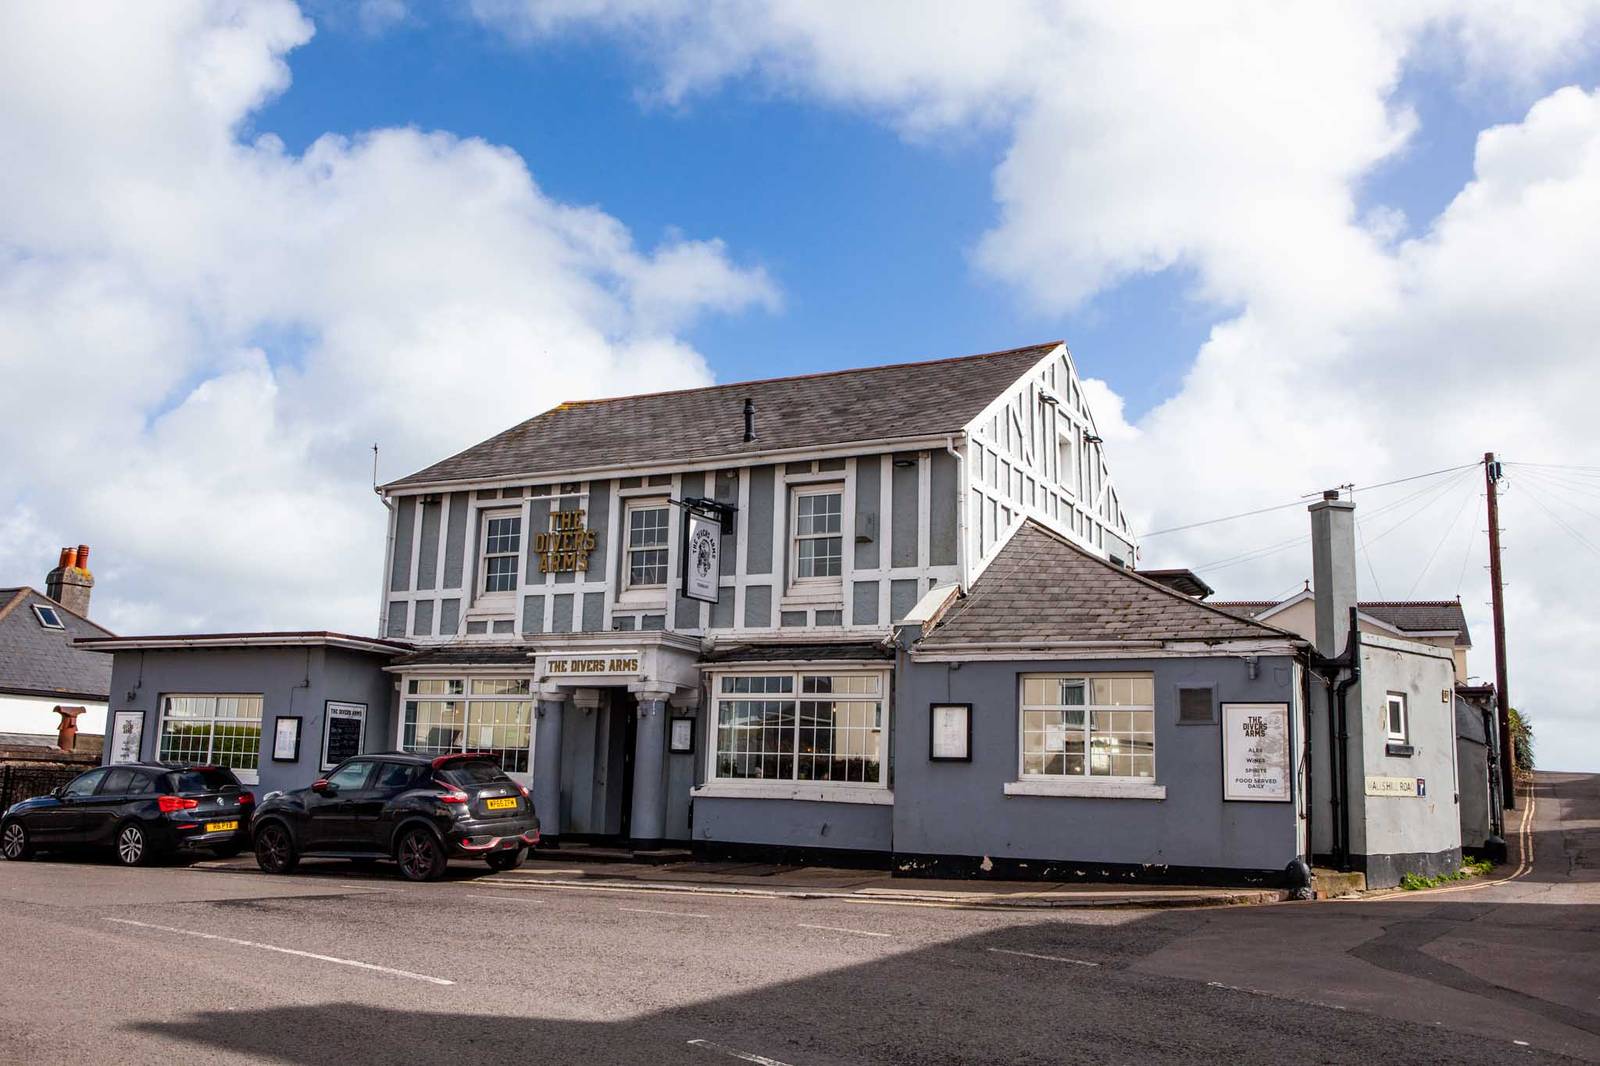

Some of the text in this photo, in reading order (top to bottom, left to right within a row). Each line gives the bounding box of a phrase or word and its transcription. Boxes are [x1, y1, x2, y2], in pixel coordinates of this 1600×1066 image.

[550, 510, 585, 530] THE
[535, 528, 596, 552] DIVERS
[539, 550, 588, 573] ARMS
[548, 659, 638, 673] THE DIVERS ARMS
[1400, 781, 1414, 791] ROAD
